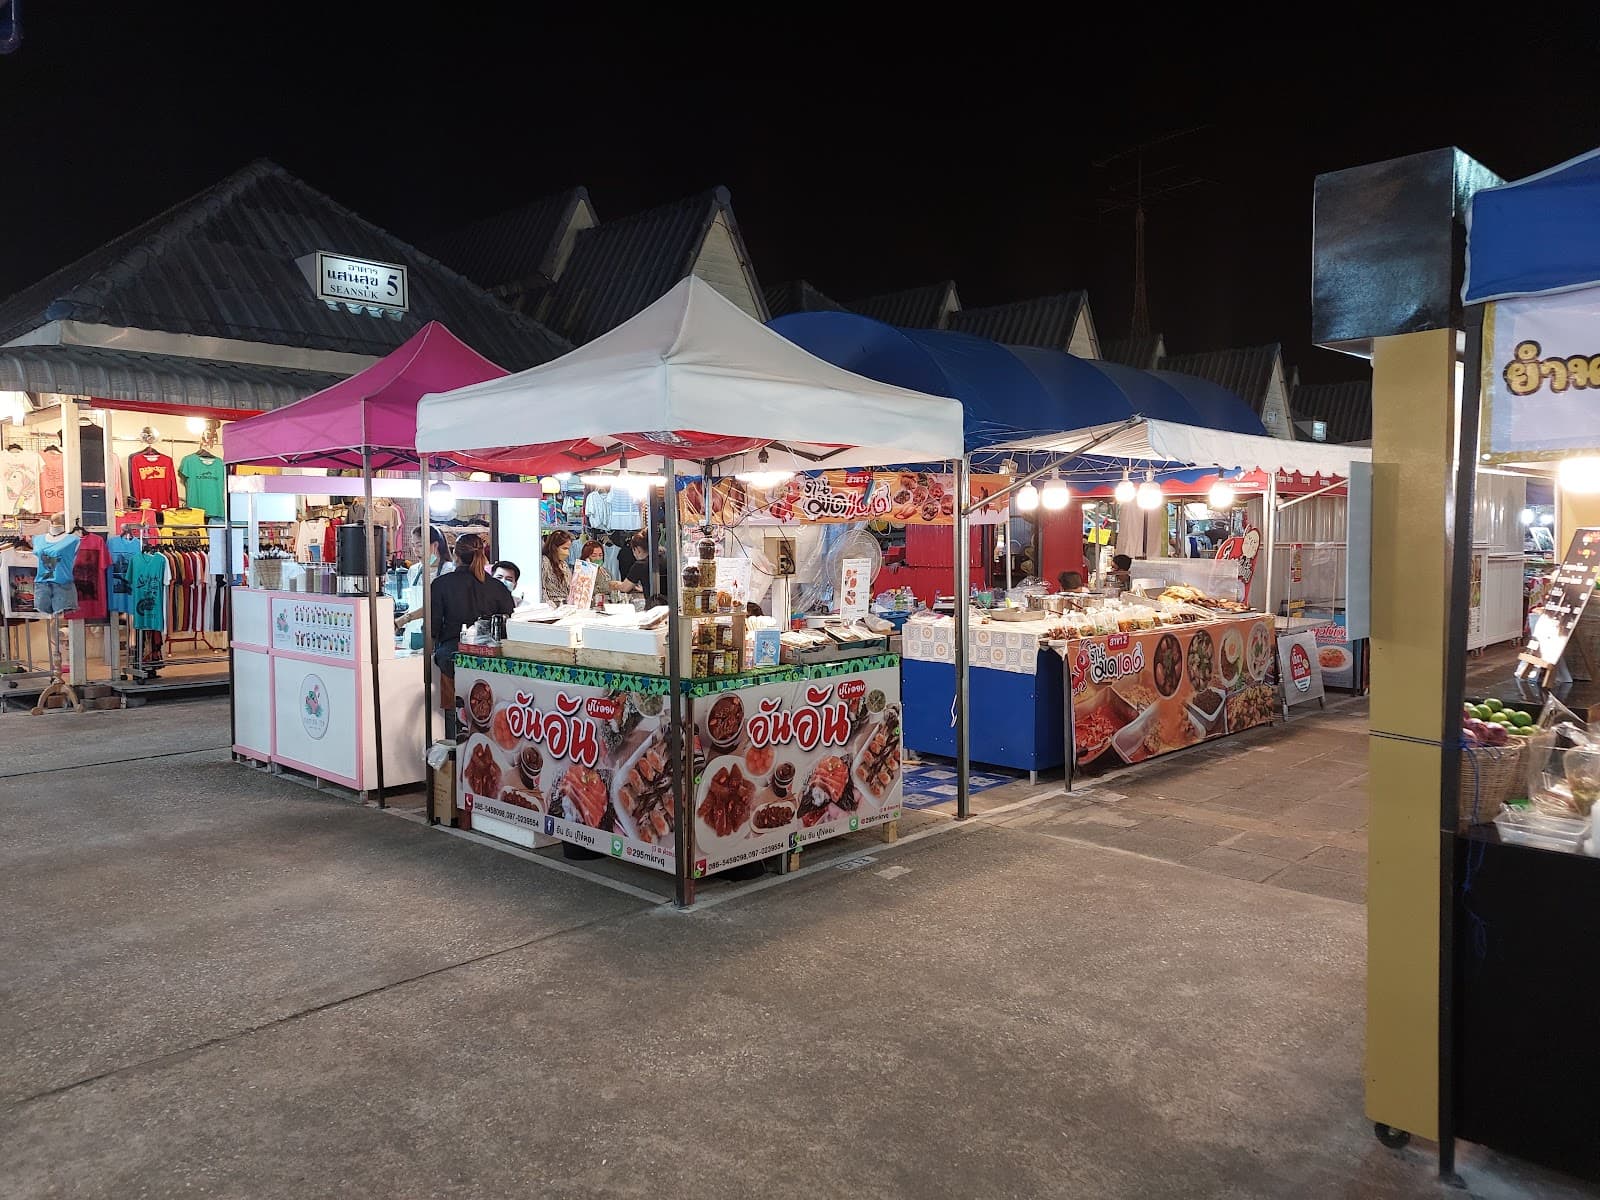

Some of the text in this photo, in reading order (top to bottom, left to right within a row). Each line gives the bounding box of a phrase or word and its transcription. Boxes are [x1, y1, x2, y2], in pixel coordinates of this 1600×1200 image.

[327, 269, 379, 290] แสนสุข
[386, 274, 398, 297] 5
[330, 284, 379, 299] SEANSUK
